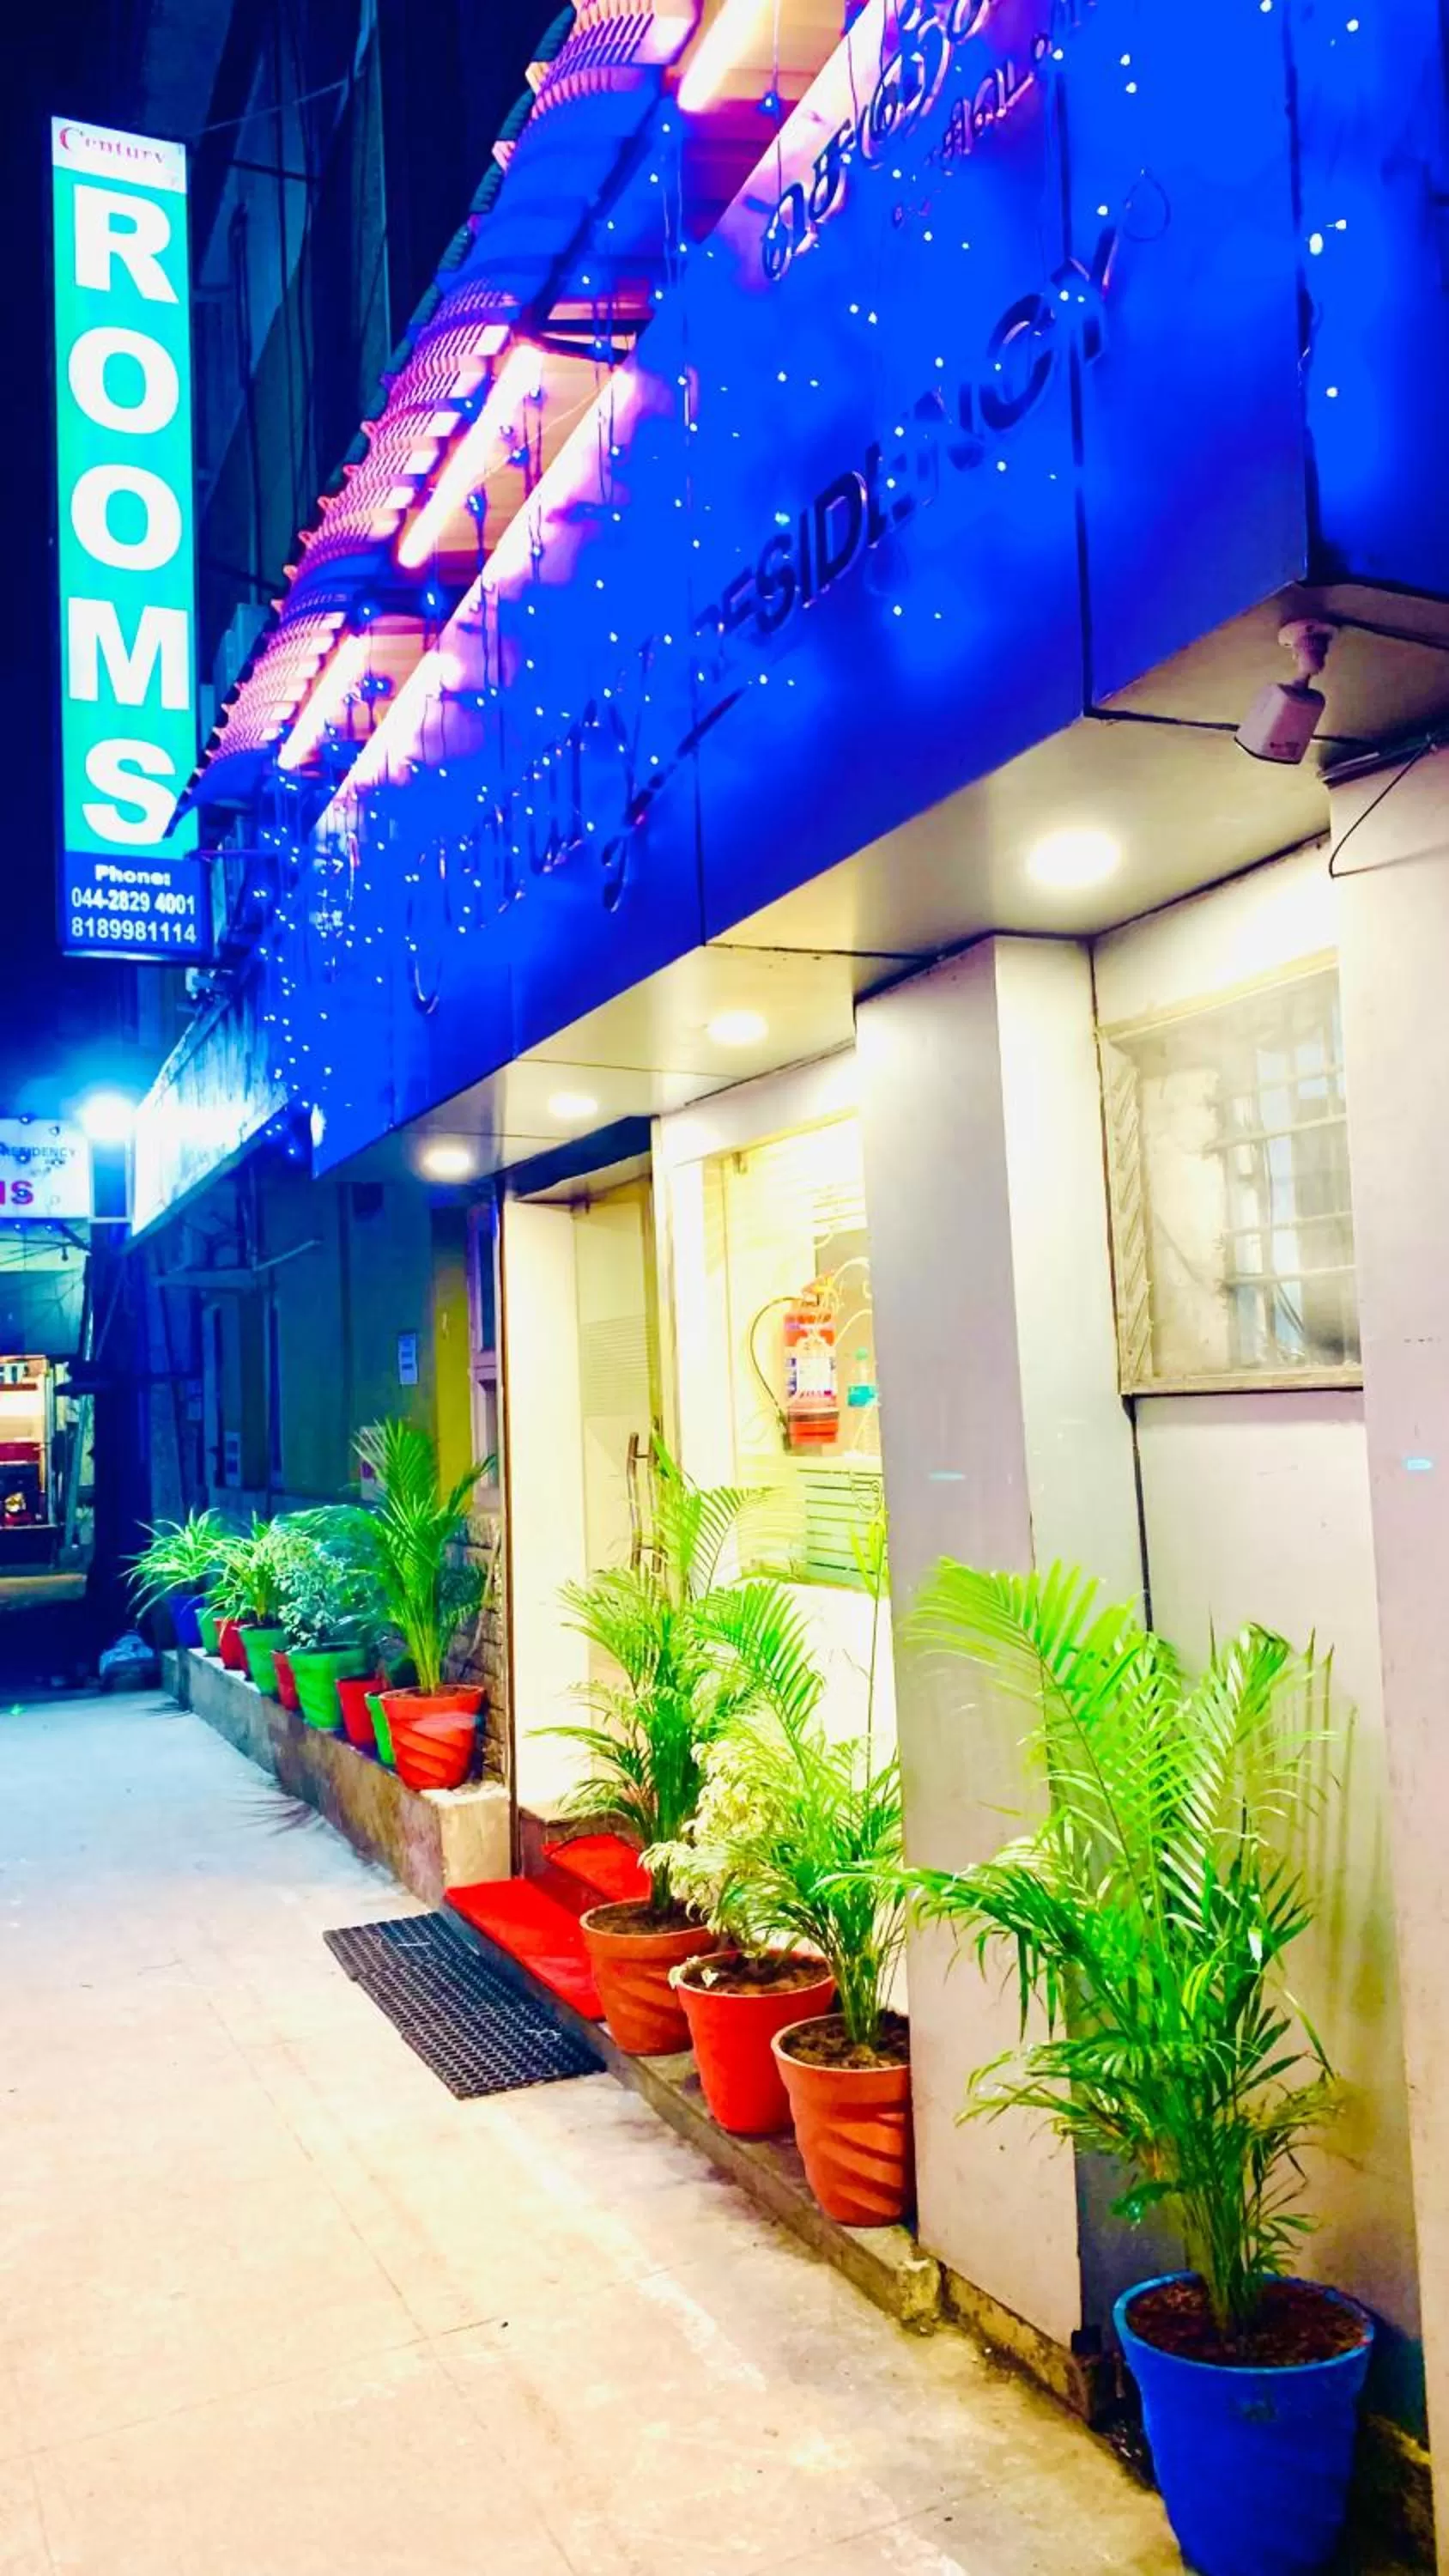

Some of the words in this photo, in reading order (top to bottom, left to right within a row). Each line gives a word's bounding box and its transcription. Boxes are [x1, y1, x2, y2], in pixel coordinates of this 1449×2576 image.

[58, 126, 166, 165] Century
[68, 184, 190, 846] ROOMS
[94, 863, 172, 887] Phone:
[70, 886, 151, 913] 044-2829
[154, 891, 196, 915] 4001
[70, 915, 197, 944] 8189981114
